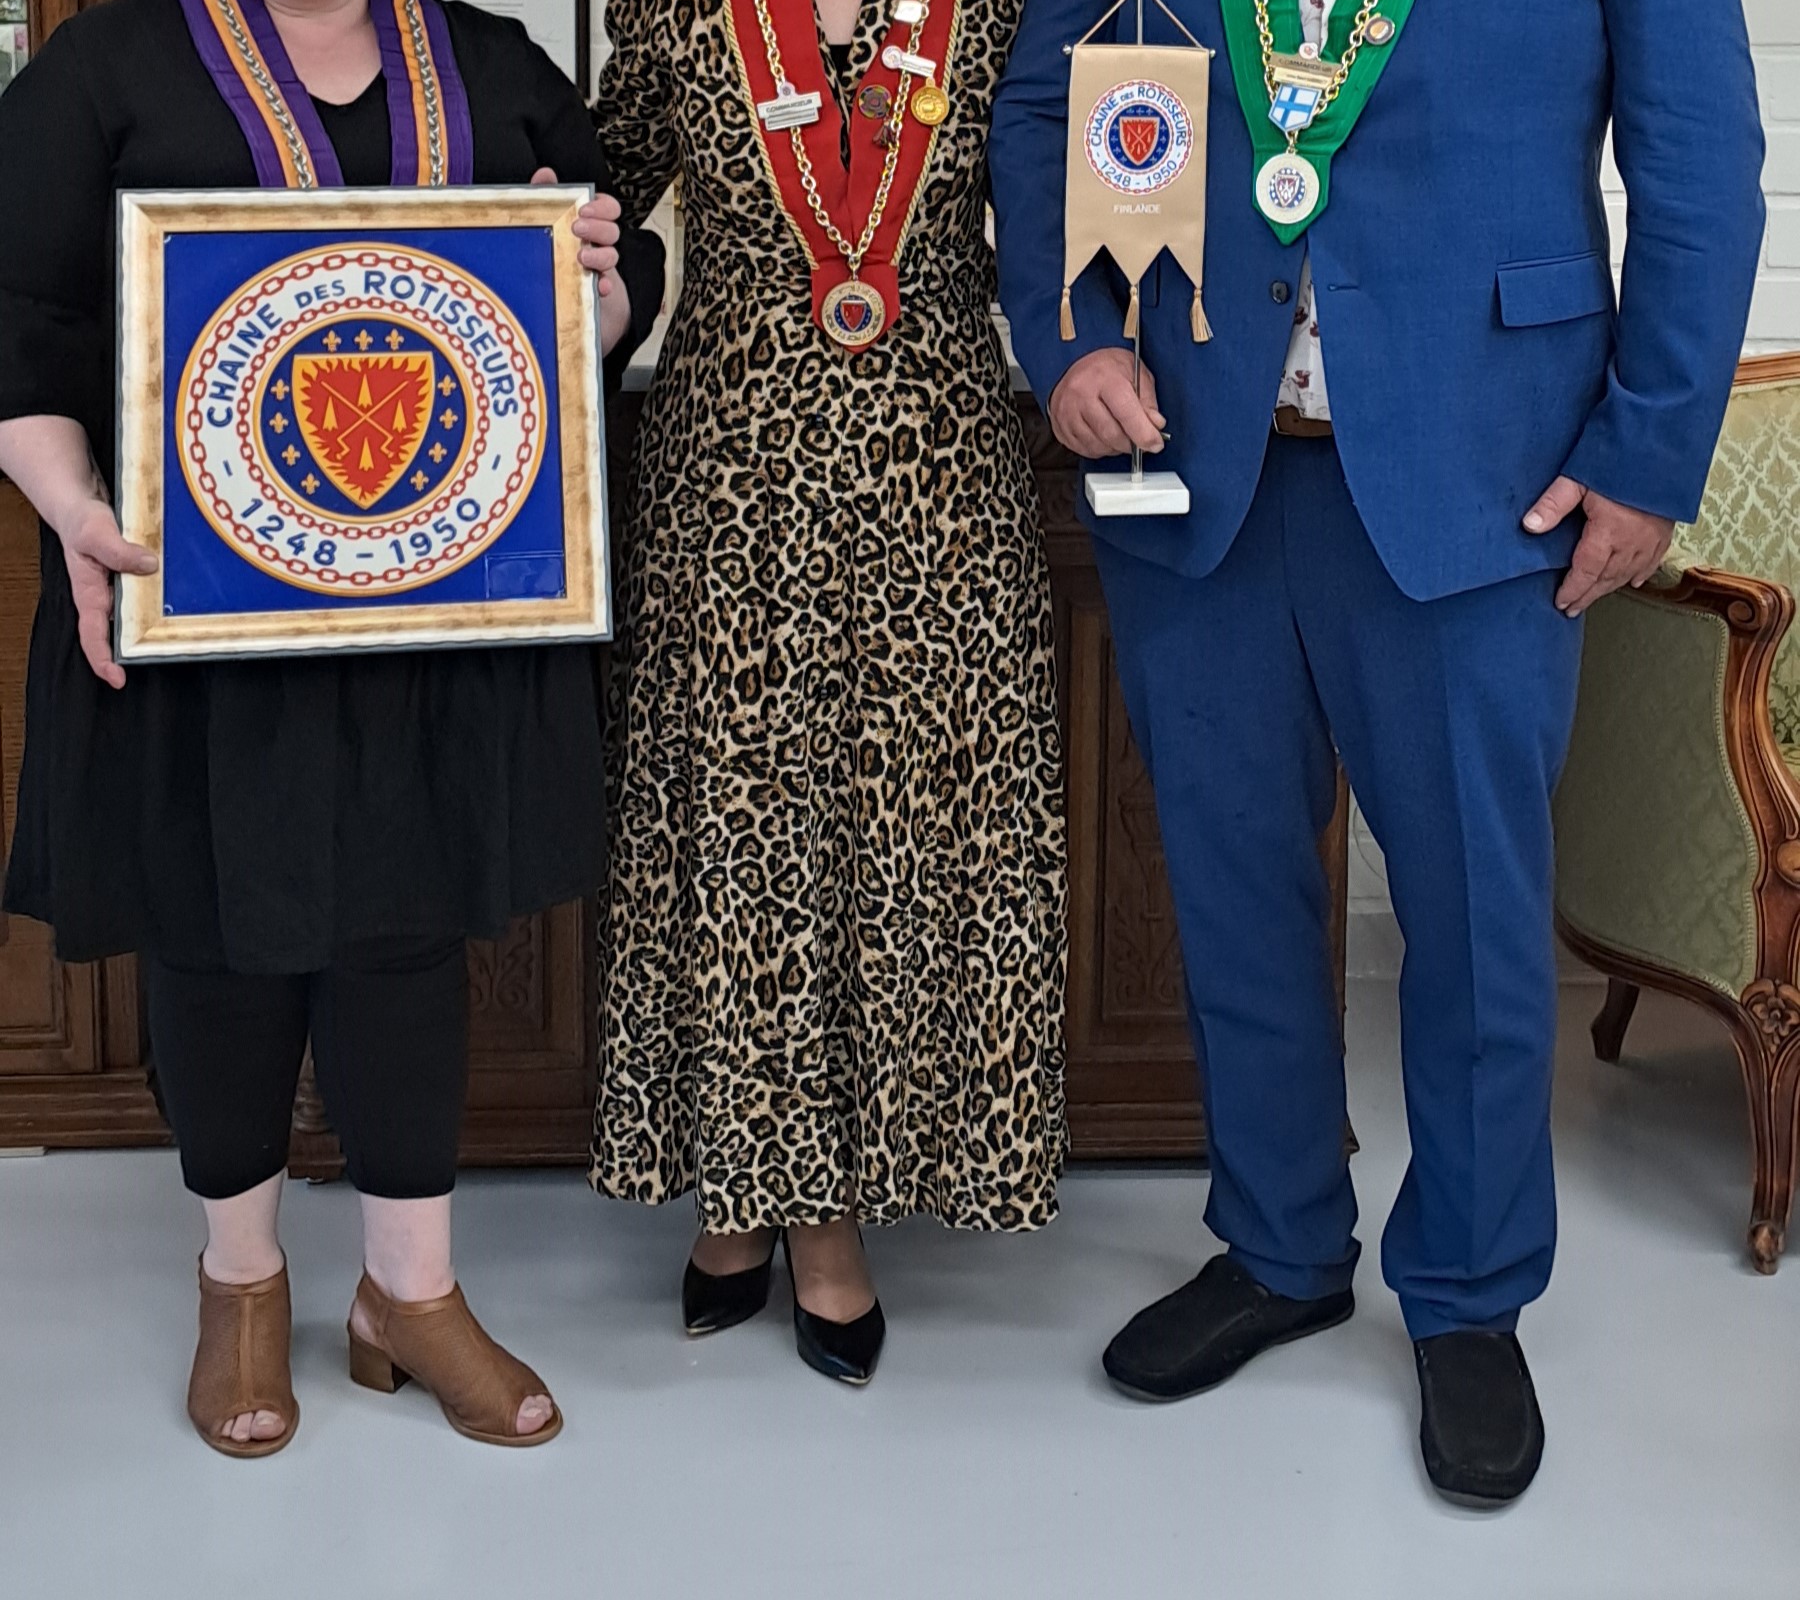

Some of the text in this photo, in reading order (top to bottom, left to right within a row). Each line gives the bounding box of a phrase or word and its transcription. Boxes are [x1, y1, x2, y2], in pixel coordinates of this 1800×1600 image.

[1090, 95, 1119, 147] CHAINE
[1137, 86, 1187, 147] ROTISSEURS
[1100, 159, 1132, 187] 1248
[1145, 159, 1177, 187] 1950
[1113, 203, 1161, 215] FINLANDE
[206, 270, 519, 428] CHAINE DES ROTISSEURS
[239, 497, 337, 567] 1248
[389, 497, 482, 565] 1950
